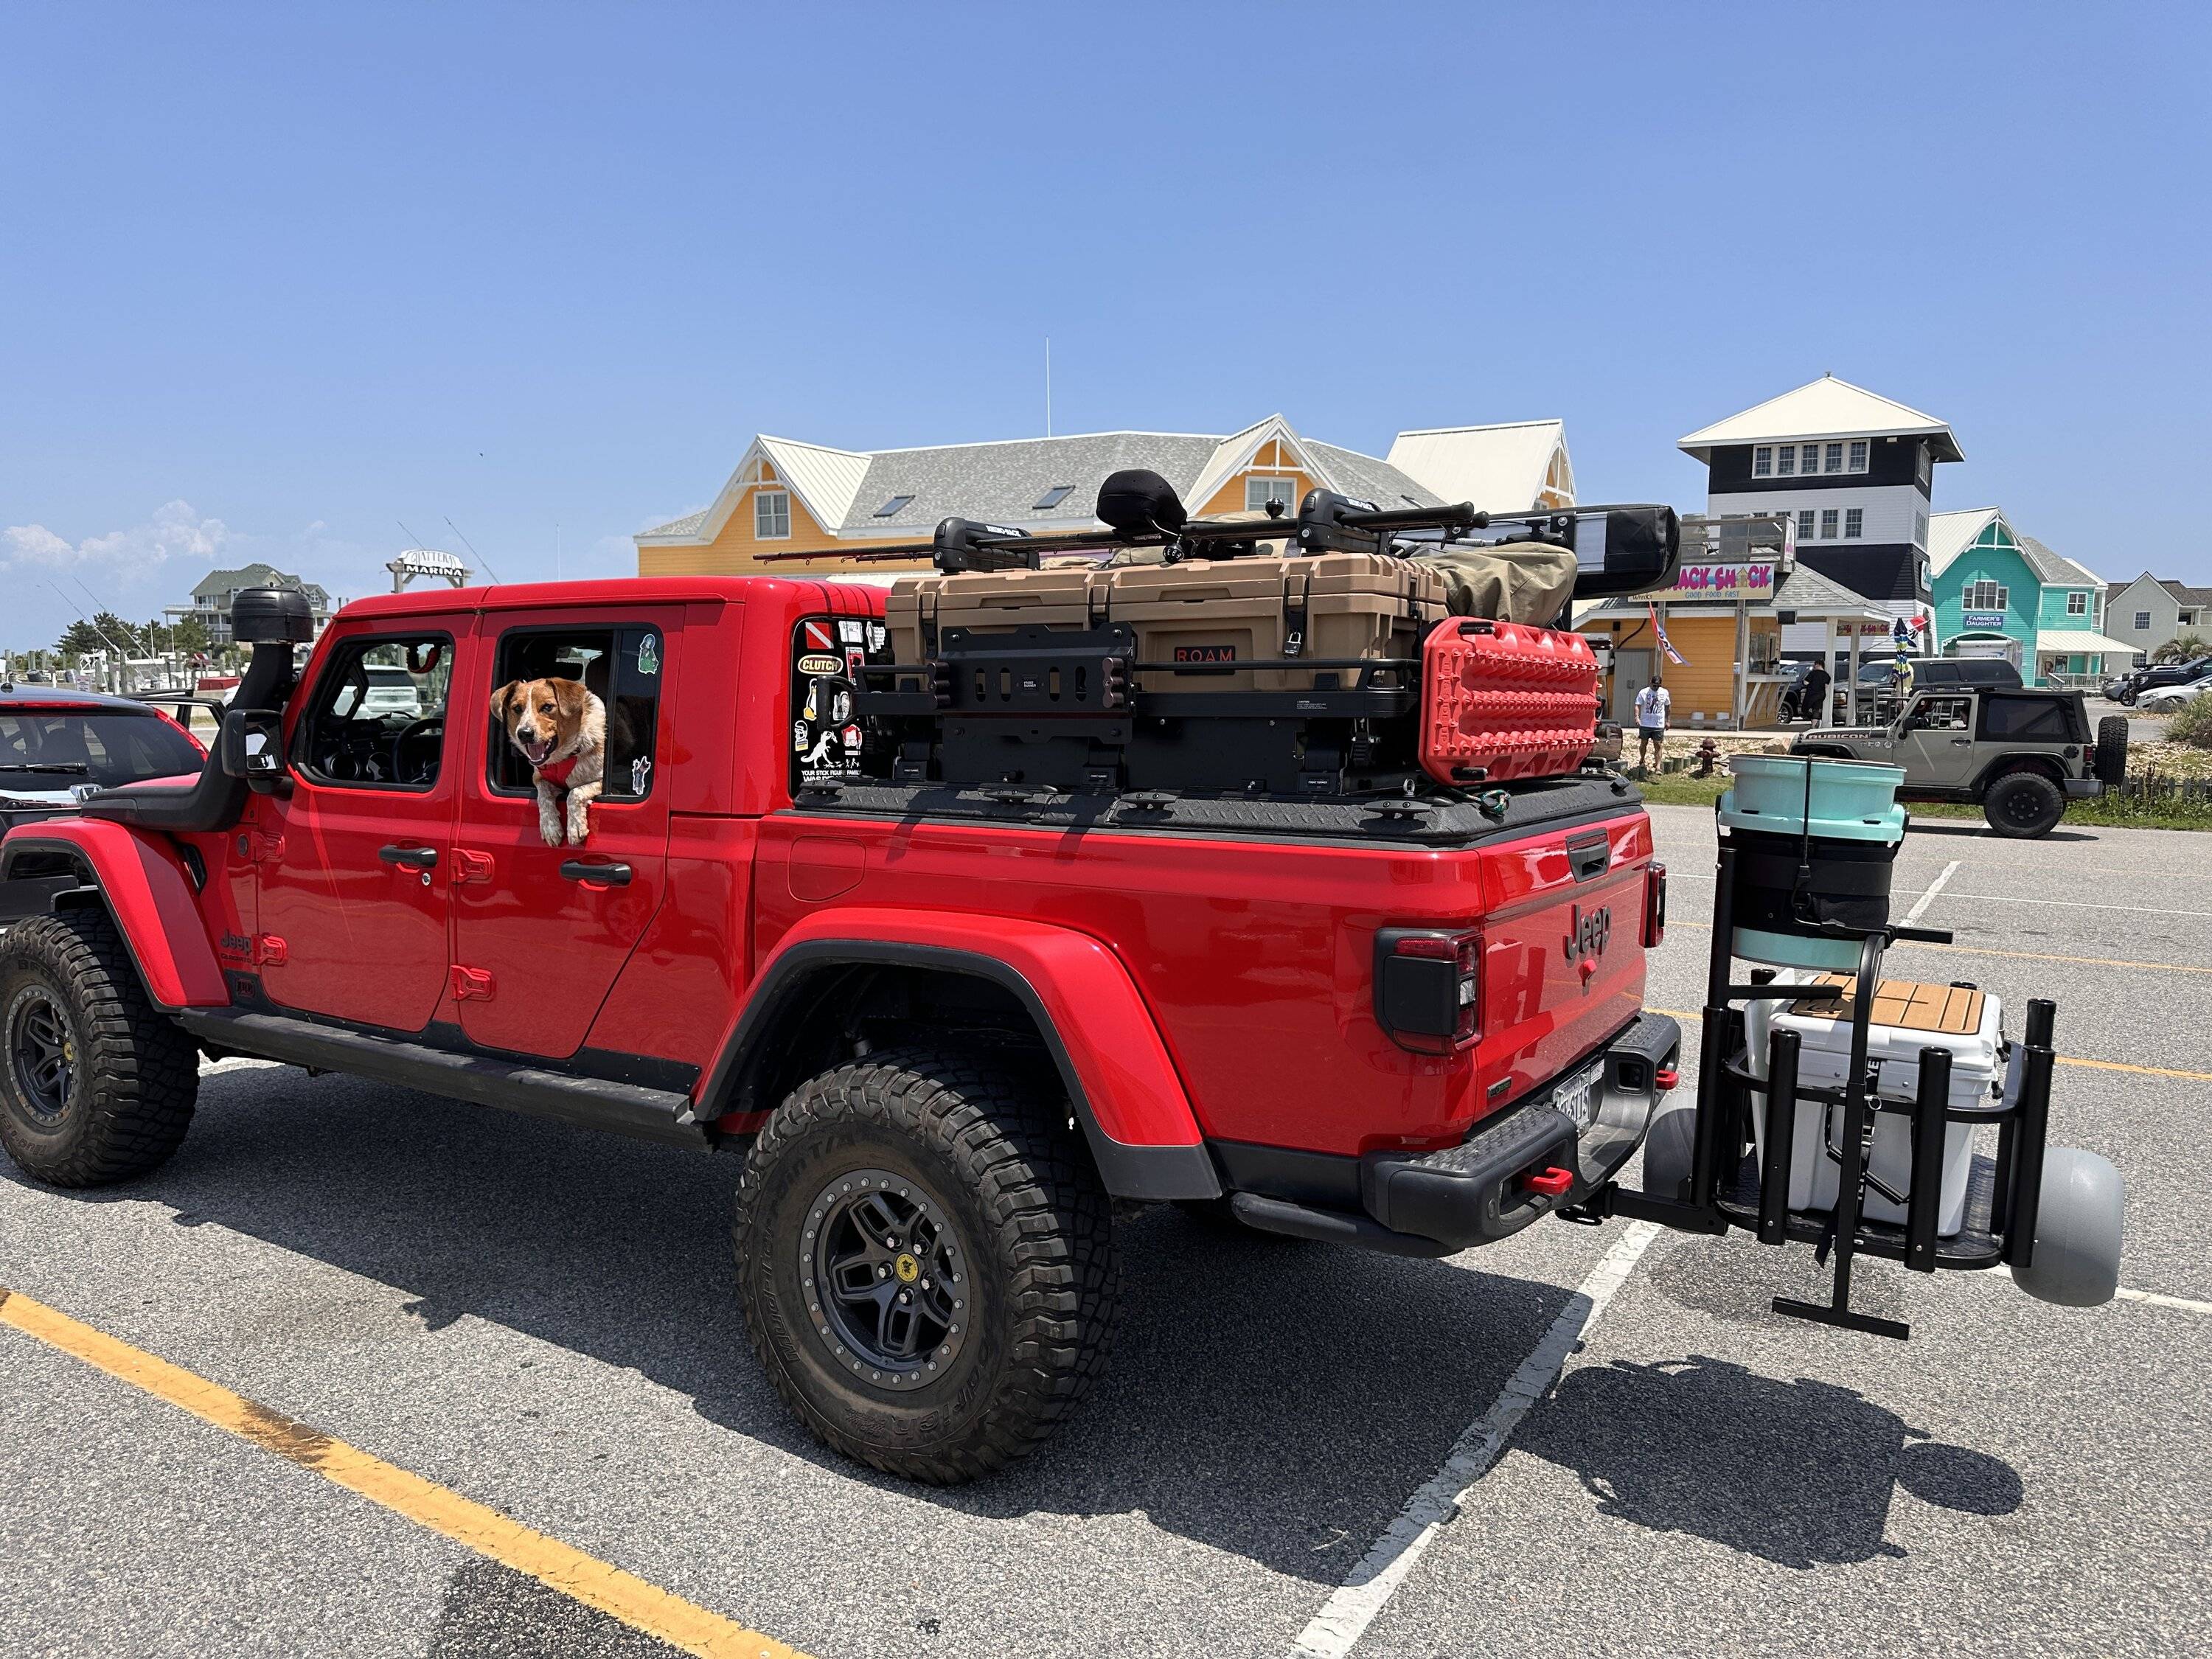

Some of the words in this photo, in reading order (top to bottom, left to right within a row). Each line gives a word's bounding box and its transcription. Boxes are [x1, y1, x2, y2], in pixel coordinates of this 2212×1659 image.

[406, 565, 462, 576] MARINA
[801, 659, 839, 672] CLUTCH
[1563, 904, 1611, 959] Jeep
[221, 928, 251, 956] Jeep
